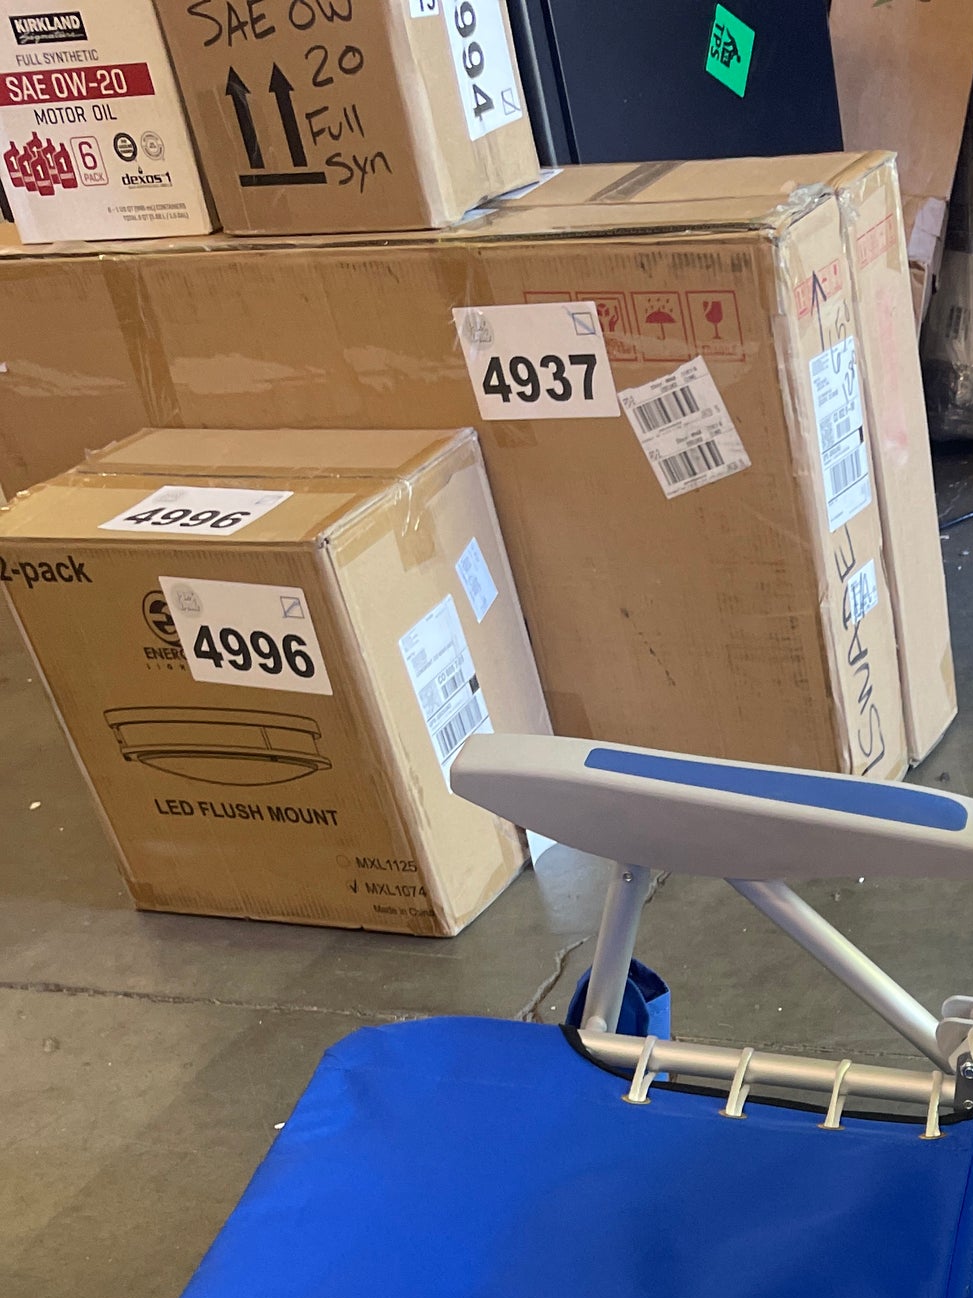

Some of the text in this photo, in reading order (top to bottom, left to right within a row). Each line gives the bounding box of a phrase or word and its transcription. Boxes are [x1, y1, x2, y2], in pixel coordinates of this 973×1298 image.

[14, 15, 81, 34] KIRKLAND
[187, 0, 275, 47] SAE
[16, 48, 99, 67] FULL SYNTHETIC
[710, 23, 724, 61] TPS
[305, 45, 364, 87] 20
[5, 68, 127, 102] SAE 0W-20
[34, 104, 117, 125] MOTOR OIL
[305, 104, 364, 146] Full
[78, 140, 98, 171] 6
[83, 172, 105, 183] PACK
[325, 152, 393, 194] Syn
[482, 353, 597, 403] 4937
[124, 507, 251, 529] 4996
[193, 625, 315, 679] 4996
[154, 798, 339, 827] LED FLUSH MOUNT
[355, 856, 418, 873] MXL1125
[365, 882, 428, 898] MXL1074
